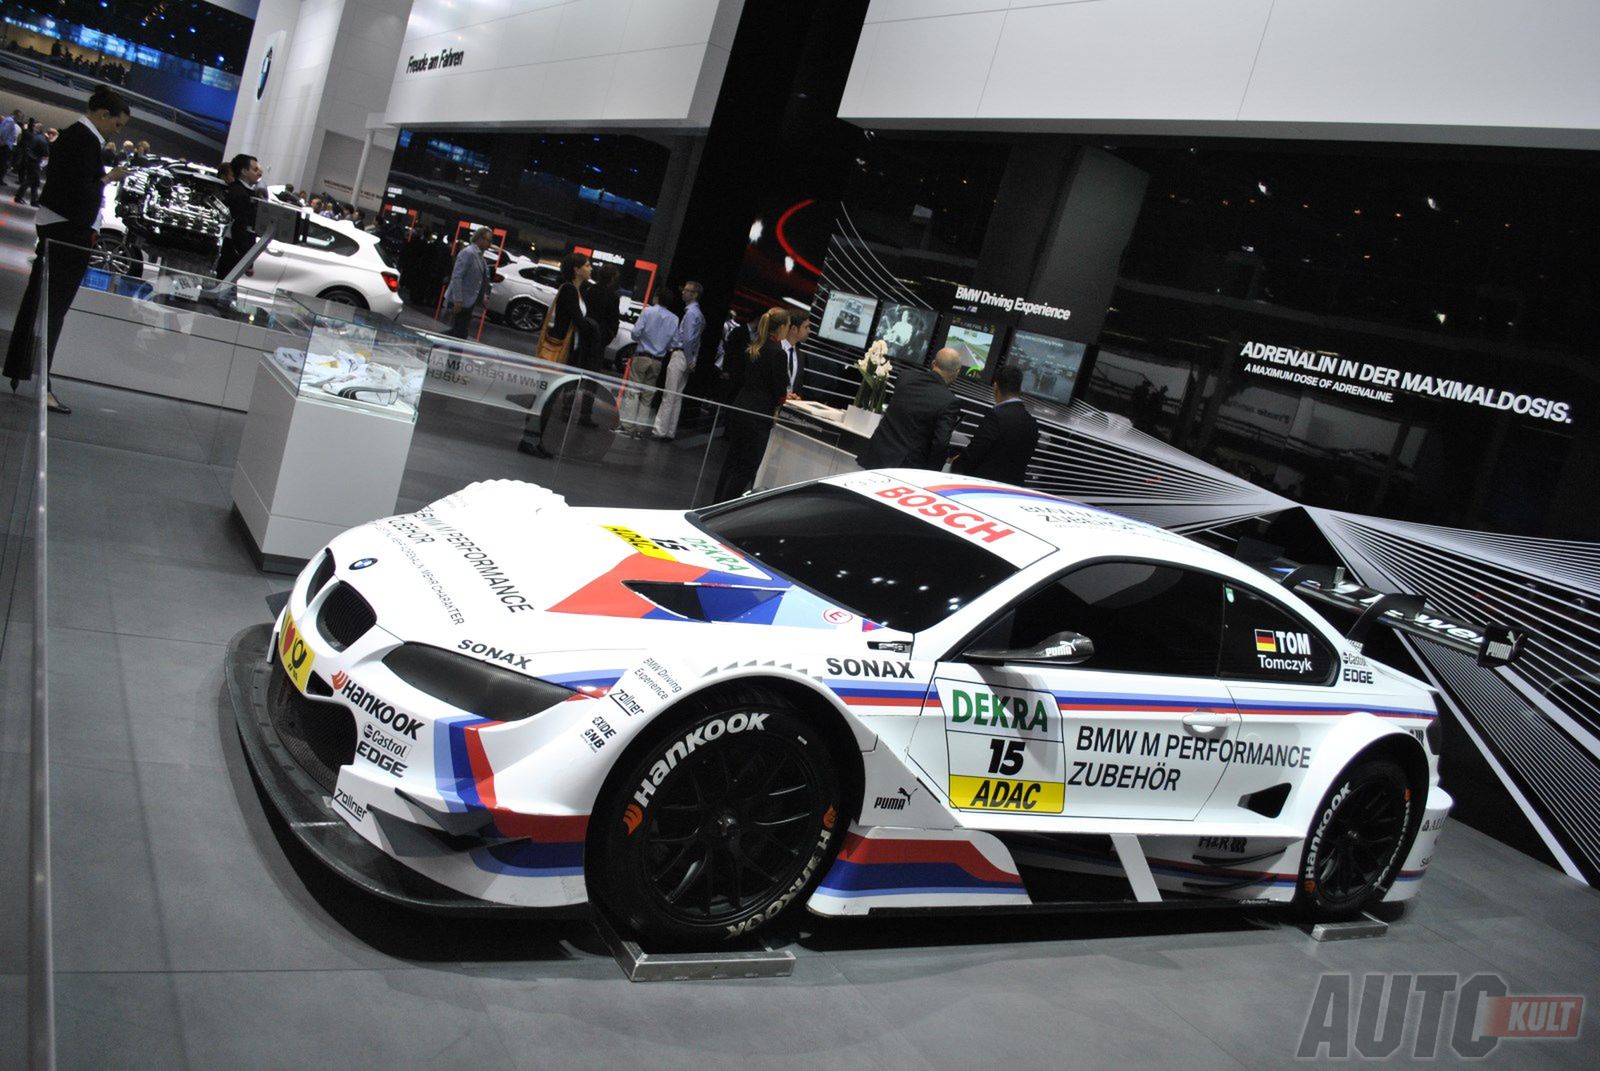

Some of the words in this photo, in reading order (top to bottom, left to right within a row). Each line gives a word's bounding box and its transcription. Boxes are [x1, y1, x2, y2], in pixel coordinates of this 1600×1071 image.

[406, 53, 429, 74] Freude
[428, 55, 439, 70] am
[439, 48, 465, 69] Fahren
[955, 286, 982, 303] BMW
[980, 290, 1014, 312] Driving
[1014, 297, 1071, 320] Experience
[1240, 341, 1338, 374] ADRENALIN
[1337, 359, 1359, 379] IN
[1358, 363, 1400, 388] DER
[1400, 371, 1572, 424] MAXIMALDOSIS.
[1244, 363, 1251, 372] A
[1251, 364, 1294, 382] MAXIMUM
[1293, 373, 1319, 387] DOSE
[1318, 378, 1333, 389] OF
[1332, 381, 1394, 403] ADRENALINE.
[874, 486, 1016, 543] BOSCH
[445, 531, 534, 613] PERFORMANCE
[457, 639, 533, 670] SONAX
[1275, 631, 1311, 655] TOM
[643, 657, 663, 673] BMW
[657, 668, 682, 694] Driving
[826, 657, 915, 680] SONAX
[1257, 653, 1312, 674] Tomczyk
[1343, 668, 1374, 684] EDGE
[634, 667, 669, 700] Experience
[951, 689, 1048, 733] DEKRA
[371, 728, 407, 758] Castrol
[584, 728, 606, 749] GNB
[592, 716, 617, 739] EXIDE
[356, 740, 408, 778] EDGE
[988, 738, 1025, 776] 15
[1076, 725, 1137, 754] BMW
[1140, 731, 1161, 758] M
[1164, 734, 1312, 769] PERFORMANCE
[1067, 761, 1181, 792] ZUBEHÖR
[970, 779, 1041, 810] ADAC
